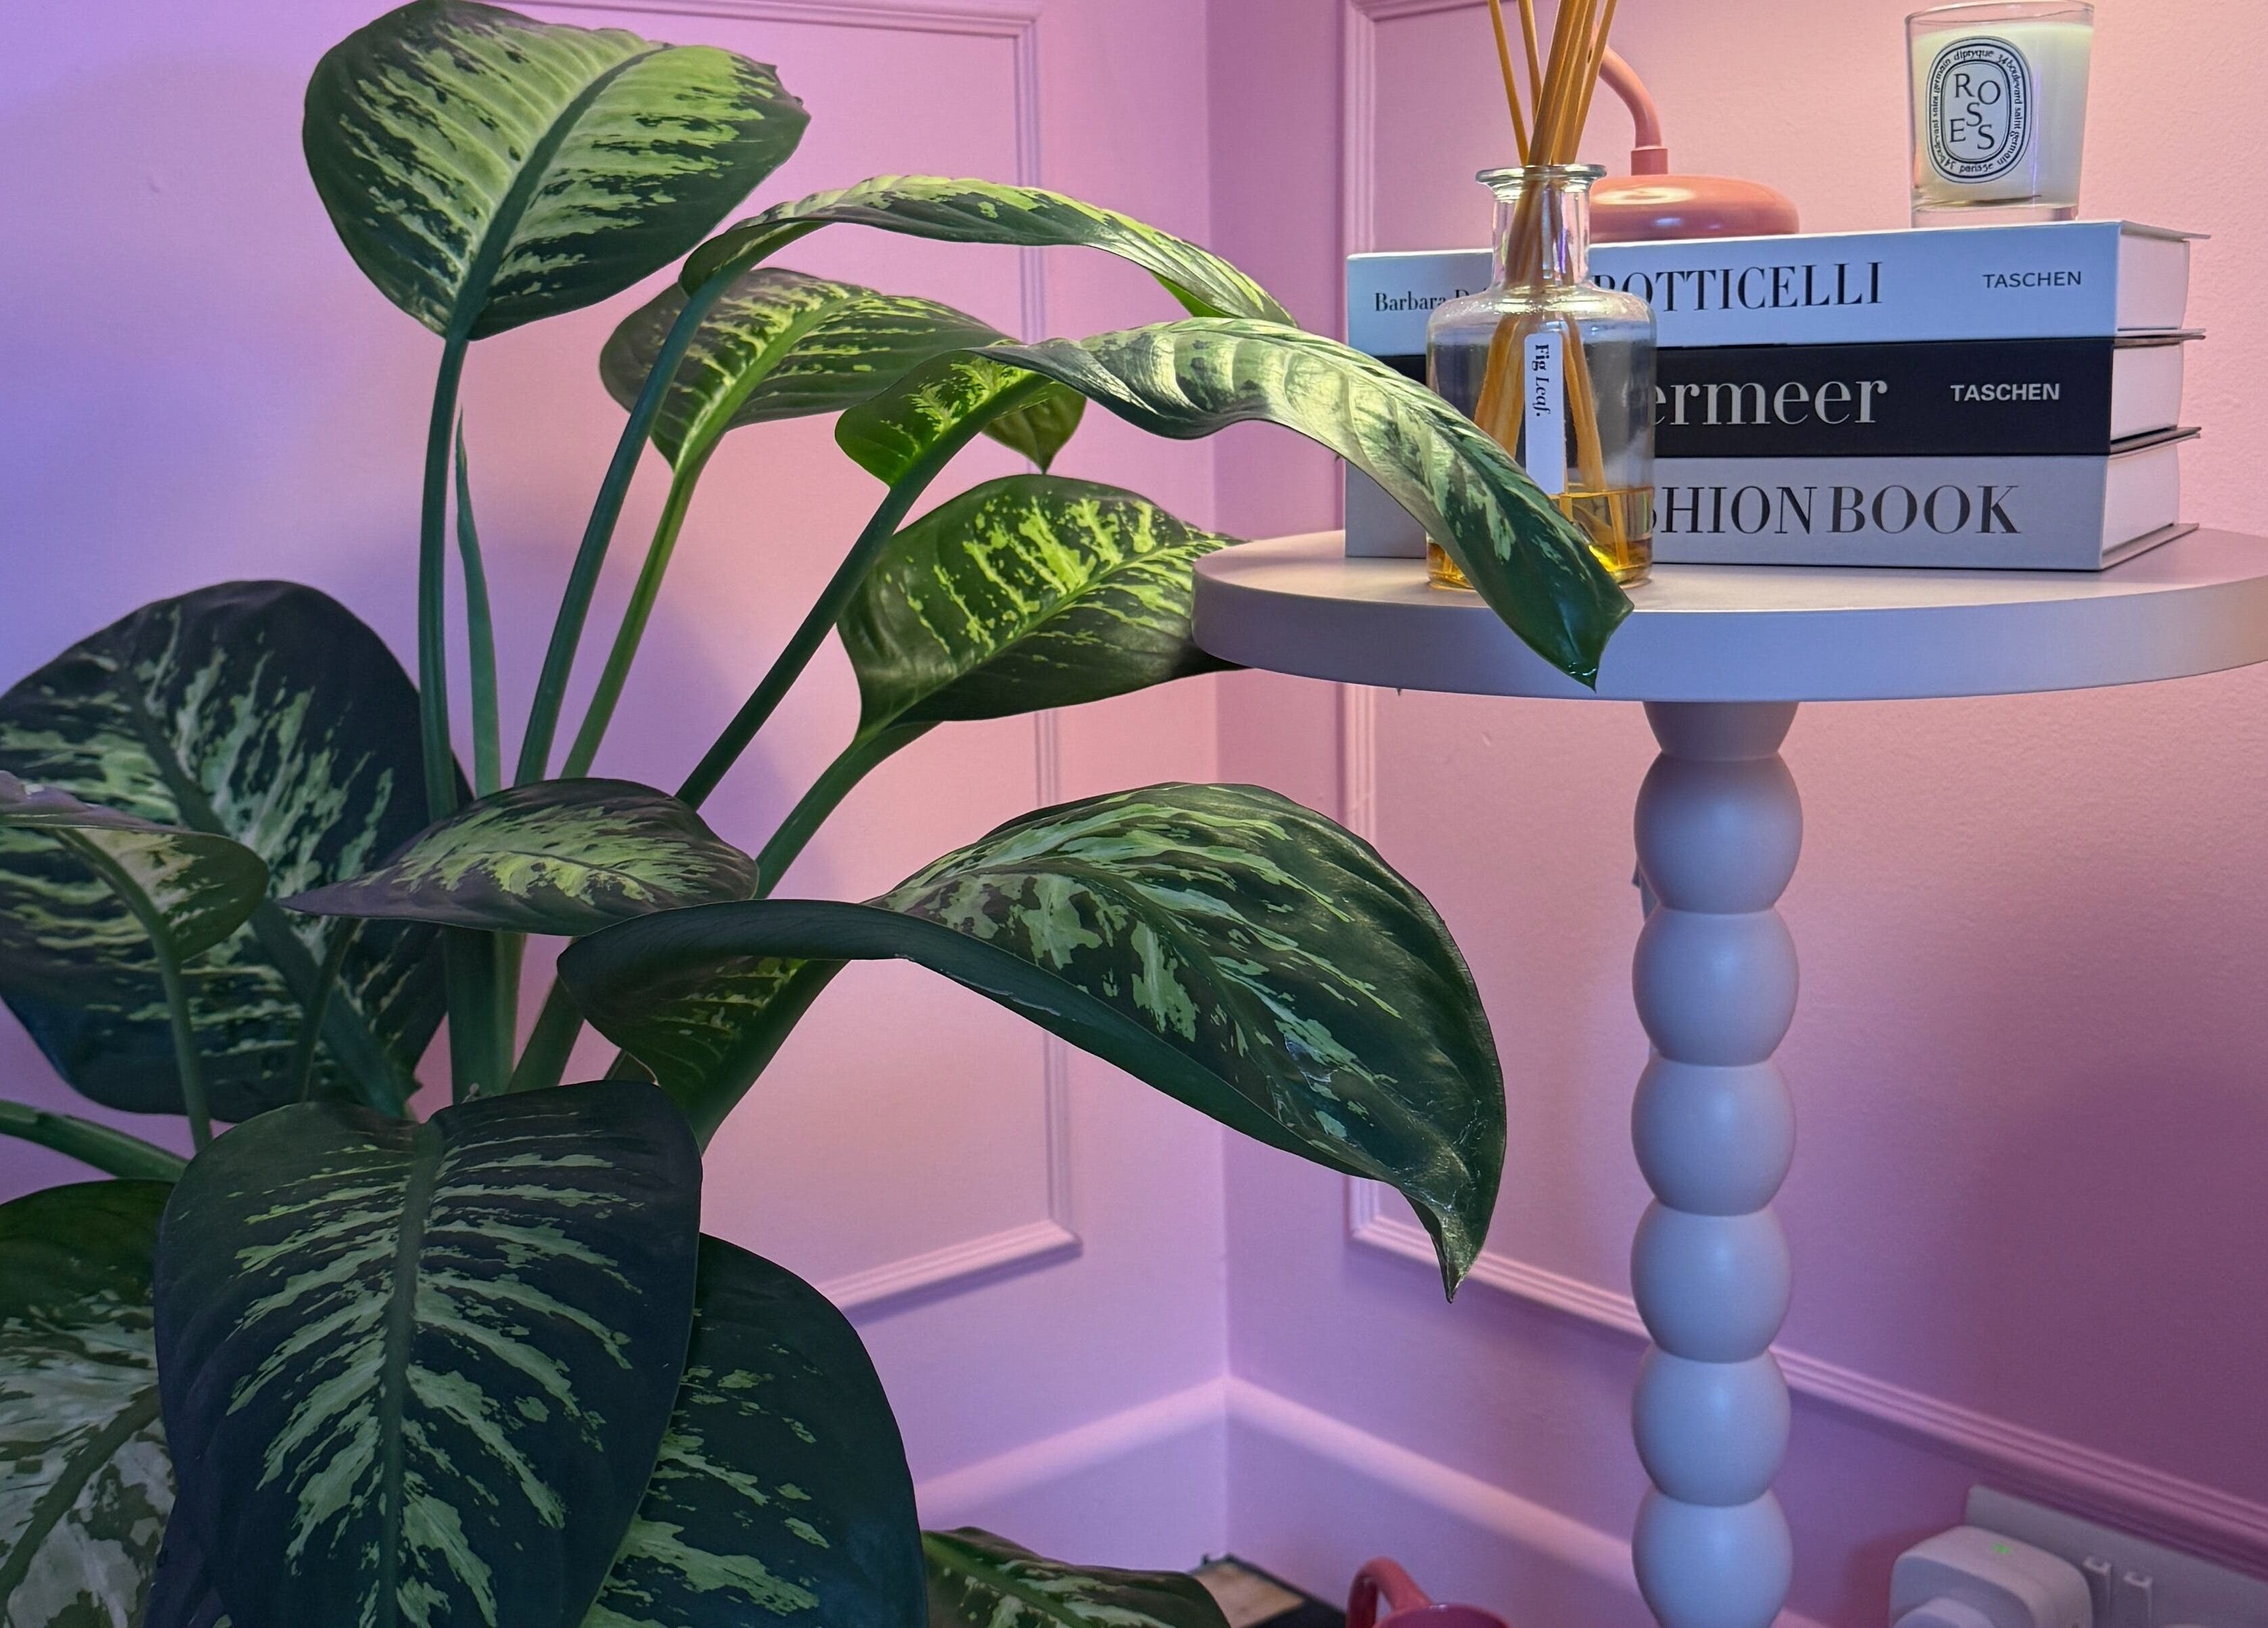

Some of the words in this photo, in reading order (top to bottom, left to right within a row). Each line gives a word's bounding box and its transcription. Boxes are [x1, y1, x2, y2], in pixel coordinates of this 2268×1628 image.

[1954, 49, 1994, 61] diptyque
[1982, 271, 2082, 288] TASCHEN
[1375, 290, 1446, 311] Barbara
[1532, 345, 1549, 371] Fig
[1532, 376, 1551, 417] Leaf.
[1655, 380, 1888, 426] rmeer
[1950, 383, 2060, 402] TASCHEN
[1652, 485, 1818, 534] HION
[1826, 485, 2021, 534] BOOK
